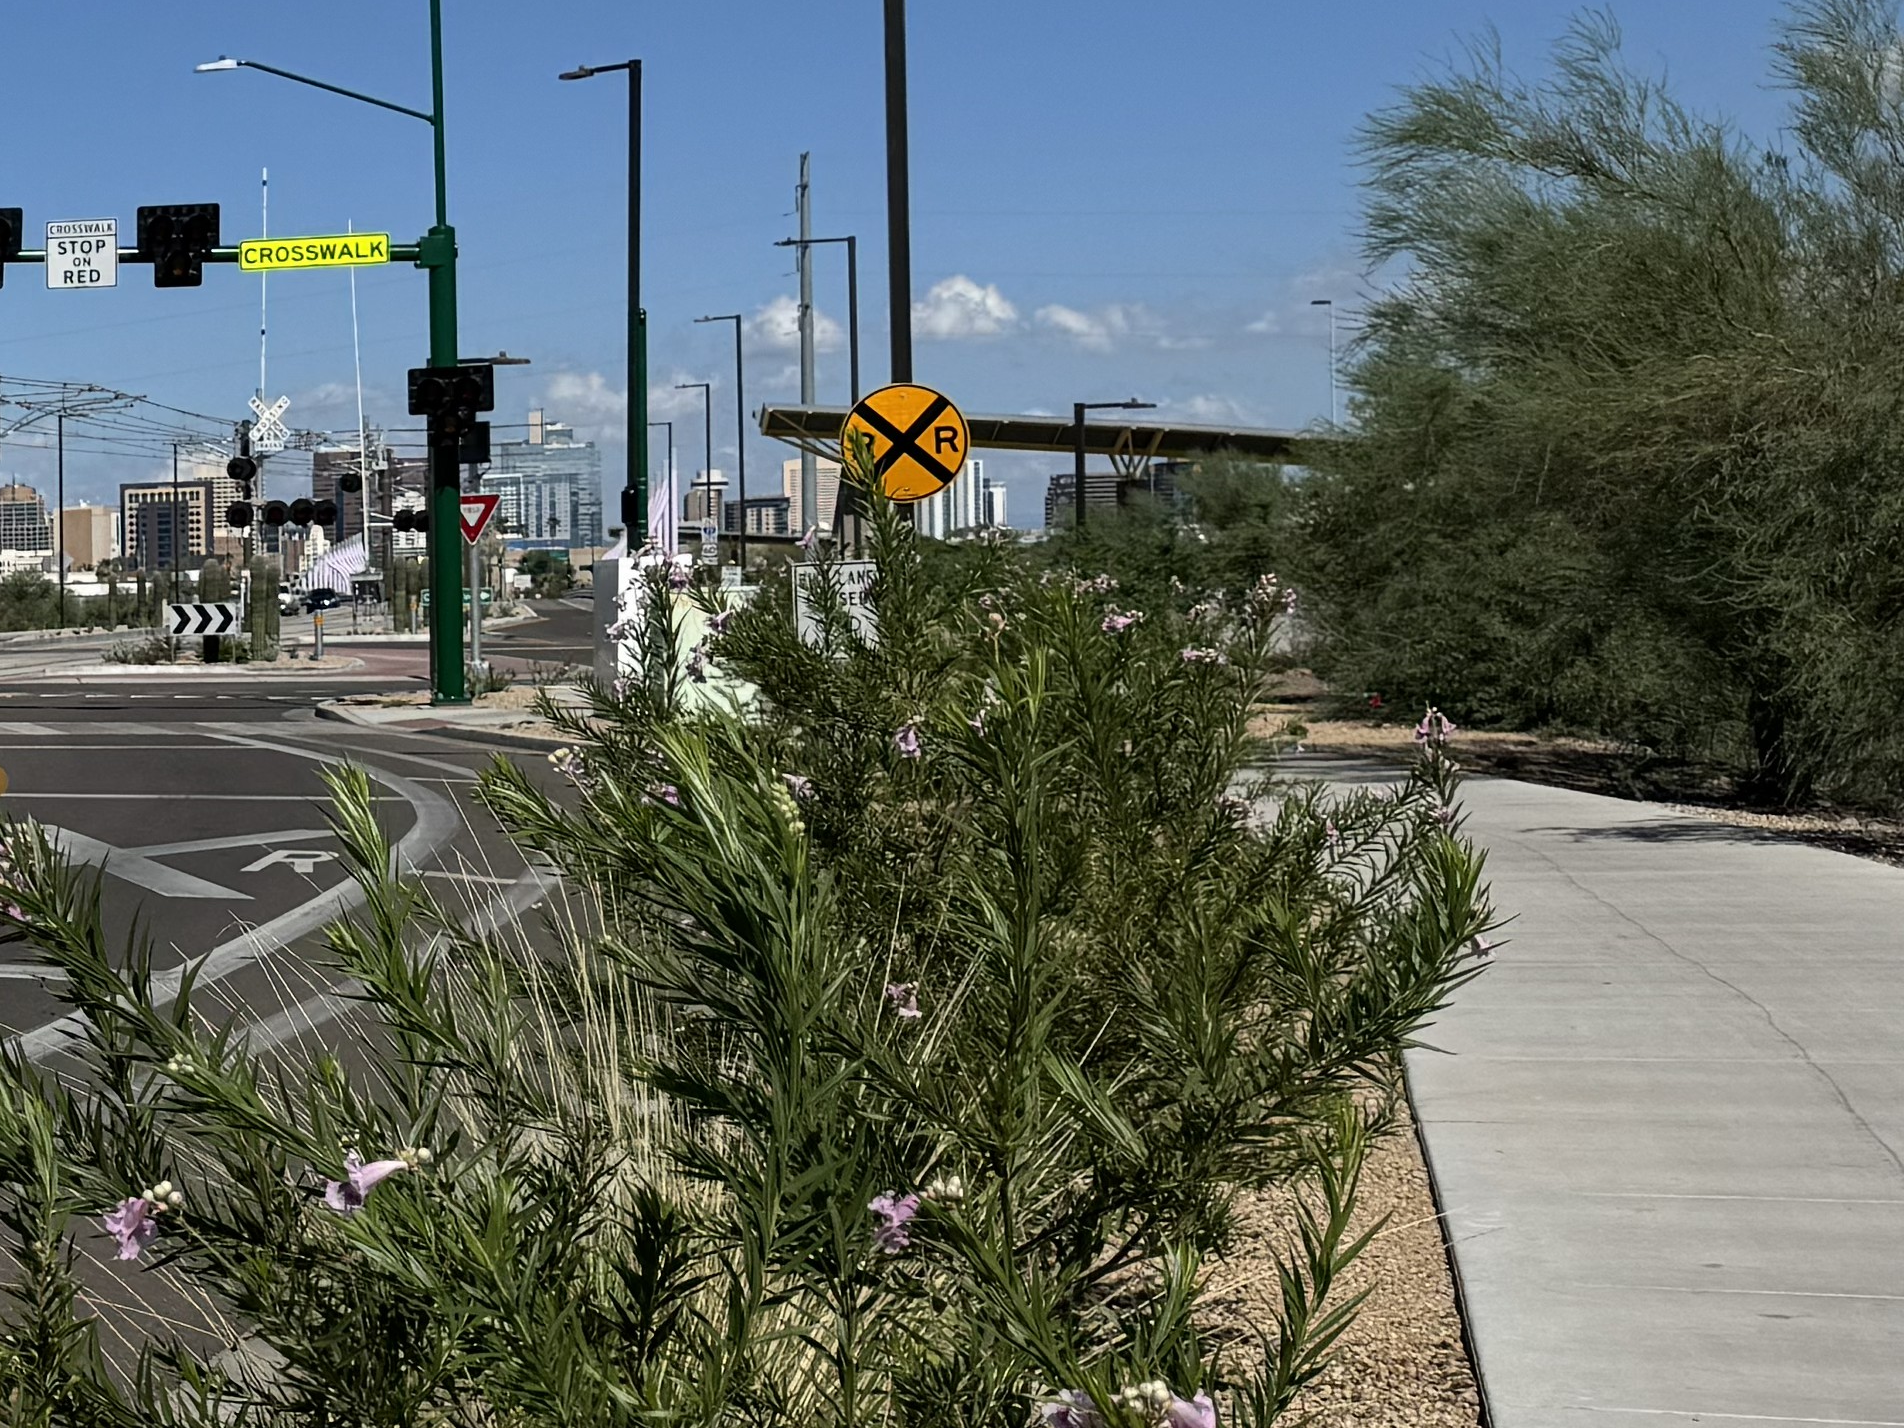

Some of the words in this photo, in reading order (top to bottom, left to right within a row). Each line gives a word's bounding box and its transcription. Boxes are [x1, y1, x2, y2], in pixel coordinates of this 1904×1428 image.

[50, 223, 113, 234] CROSSWALK
[58, 240, 106, 255] STOP
[244, 241, 384, 264] CROSSWALK
[73, 257, 91, 267] ON
[64, 269, 100, 284] RED
[934, 425, 959, 454] R
